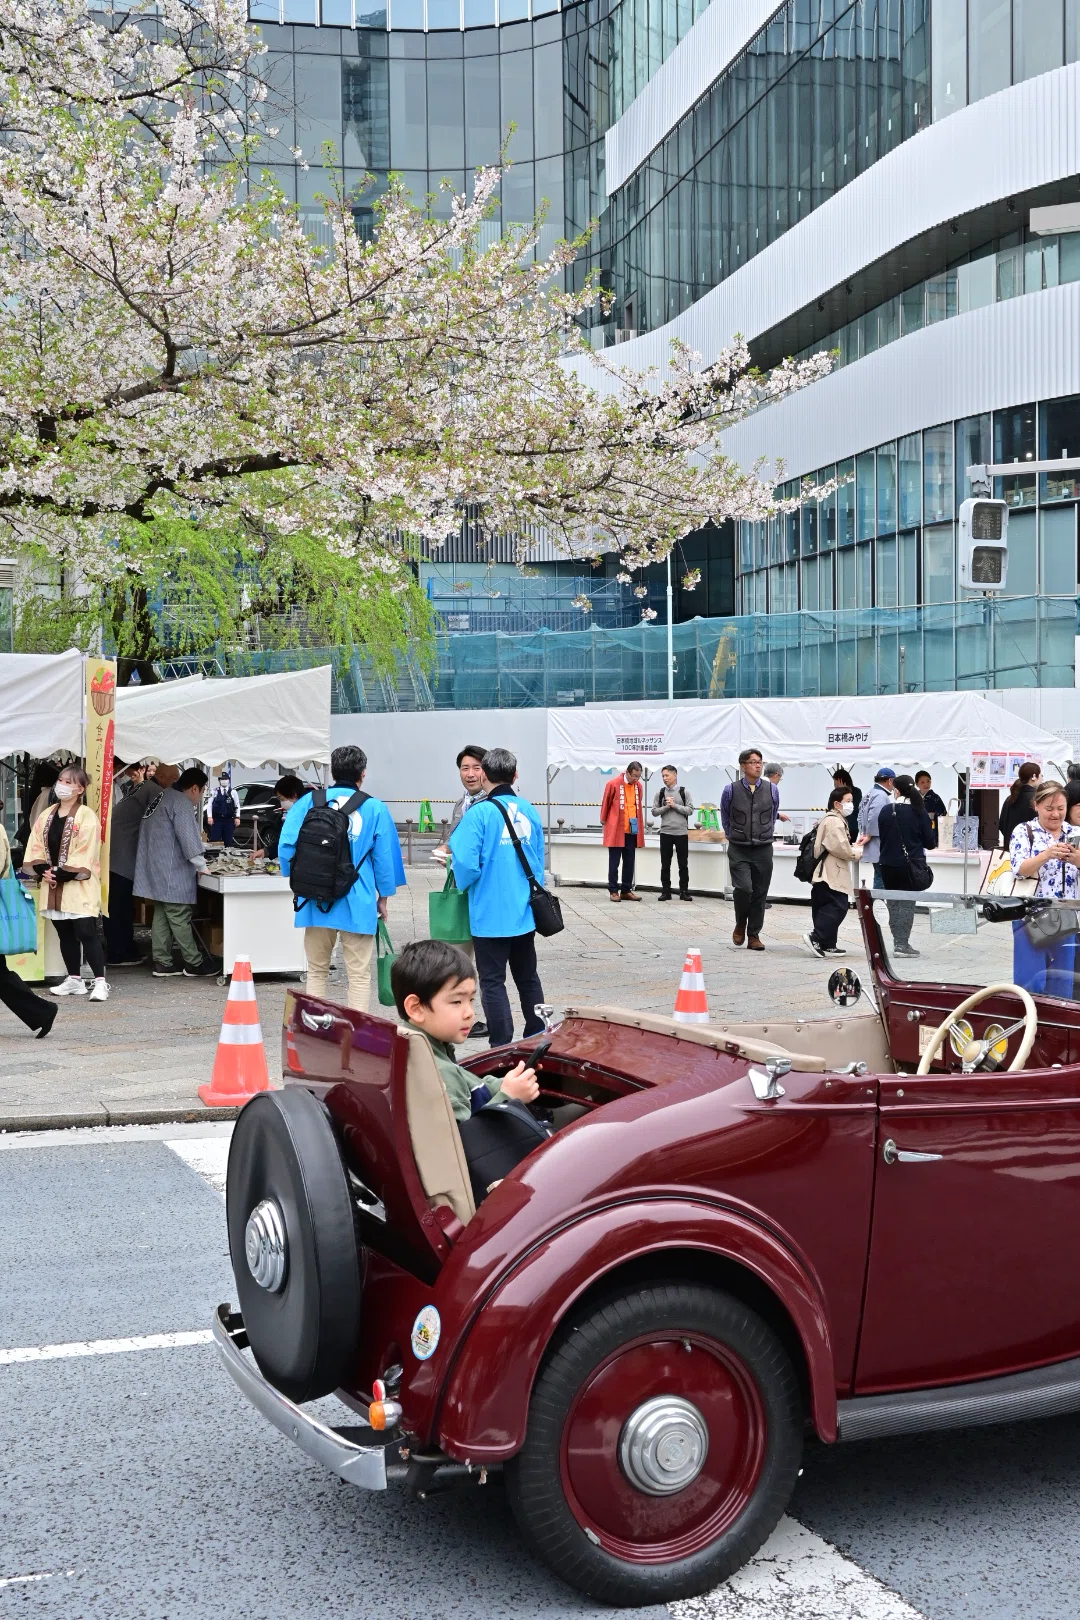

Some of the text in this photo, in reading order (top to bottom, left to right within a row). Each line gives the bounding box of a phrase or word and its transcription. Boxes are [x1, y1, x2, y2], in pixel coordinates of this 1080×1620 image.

[828, 732, 869, 743] 日本橋みやげ
